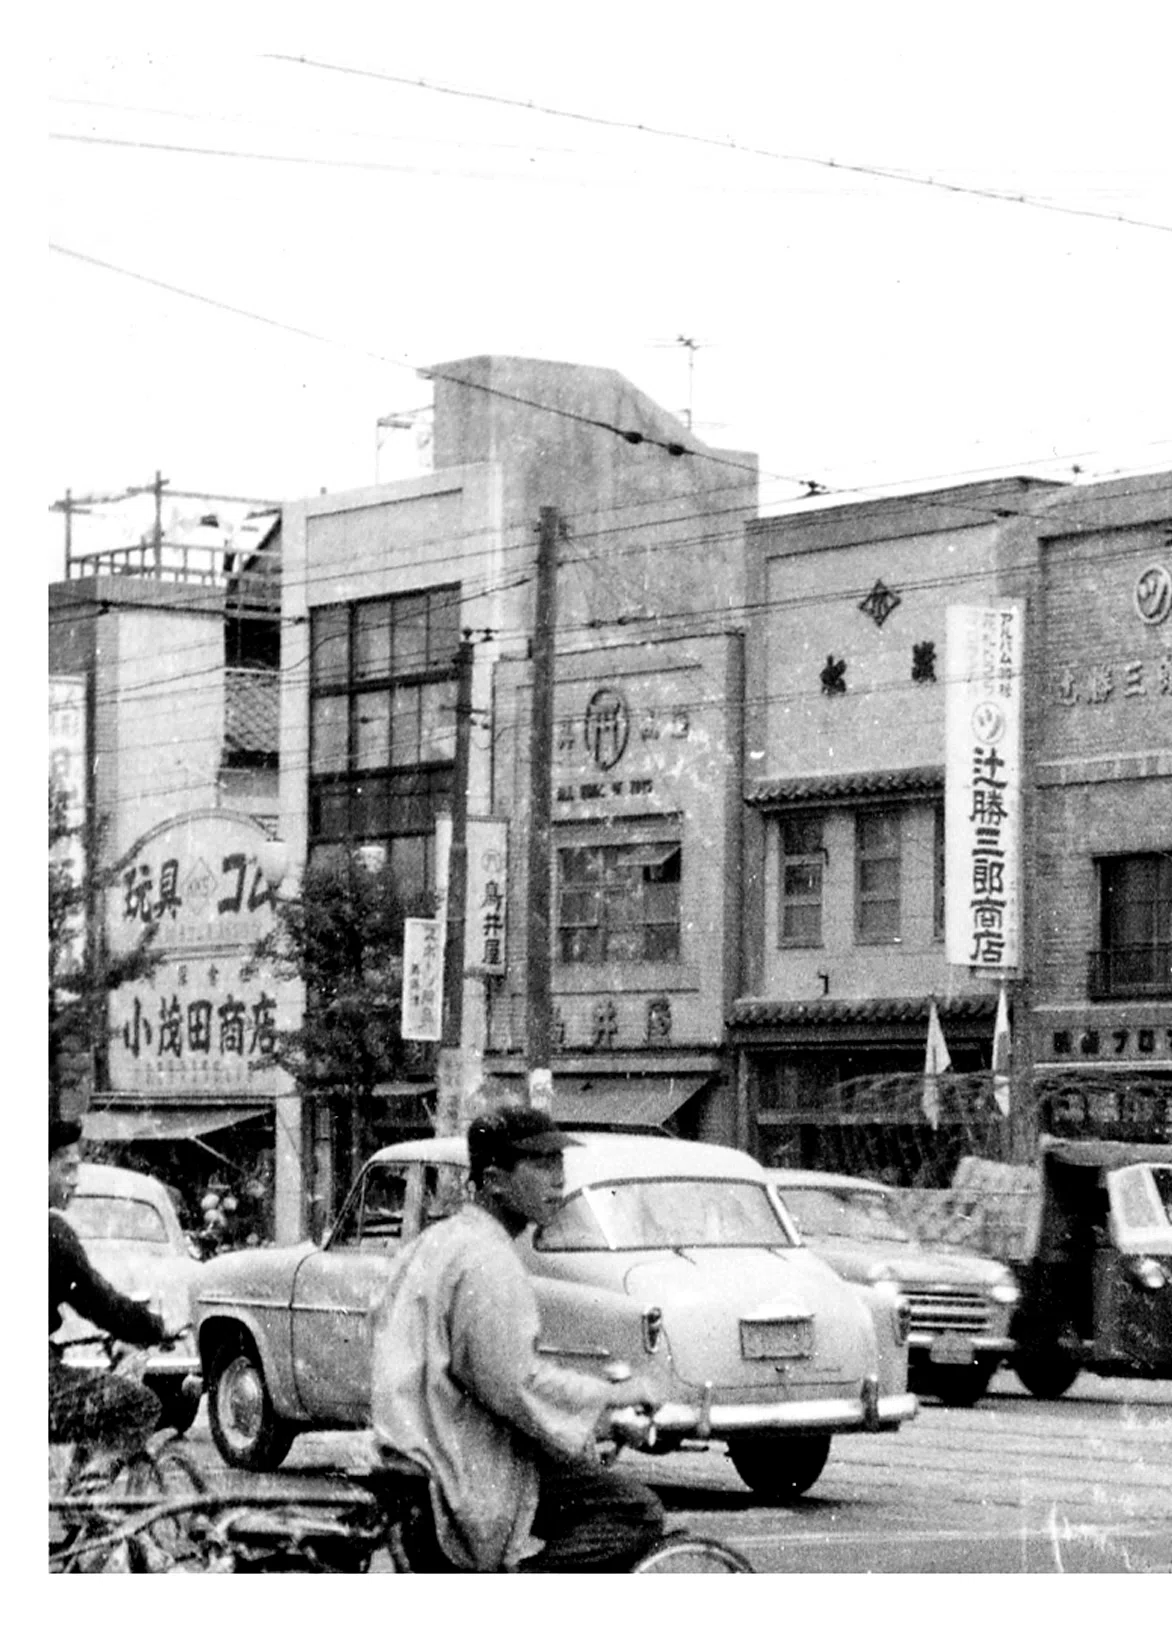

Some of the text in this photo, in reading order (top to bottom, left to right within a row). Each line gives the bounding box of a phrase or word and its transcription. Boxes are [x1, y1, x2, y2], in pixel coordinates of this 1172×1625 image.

[969, 747, 1008, 962] 辻勝三郎商店
[122, 858, 182, 923] 玩具
[123, 992, 277, 1058] 小茂田商店
